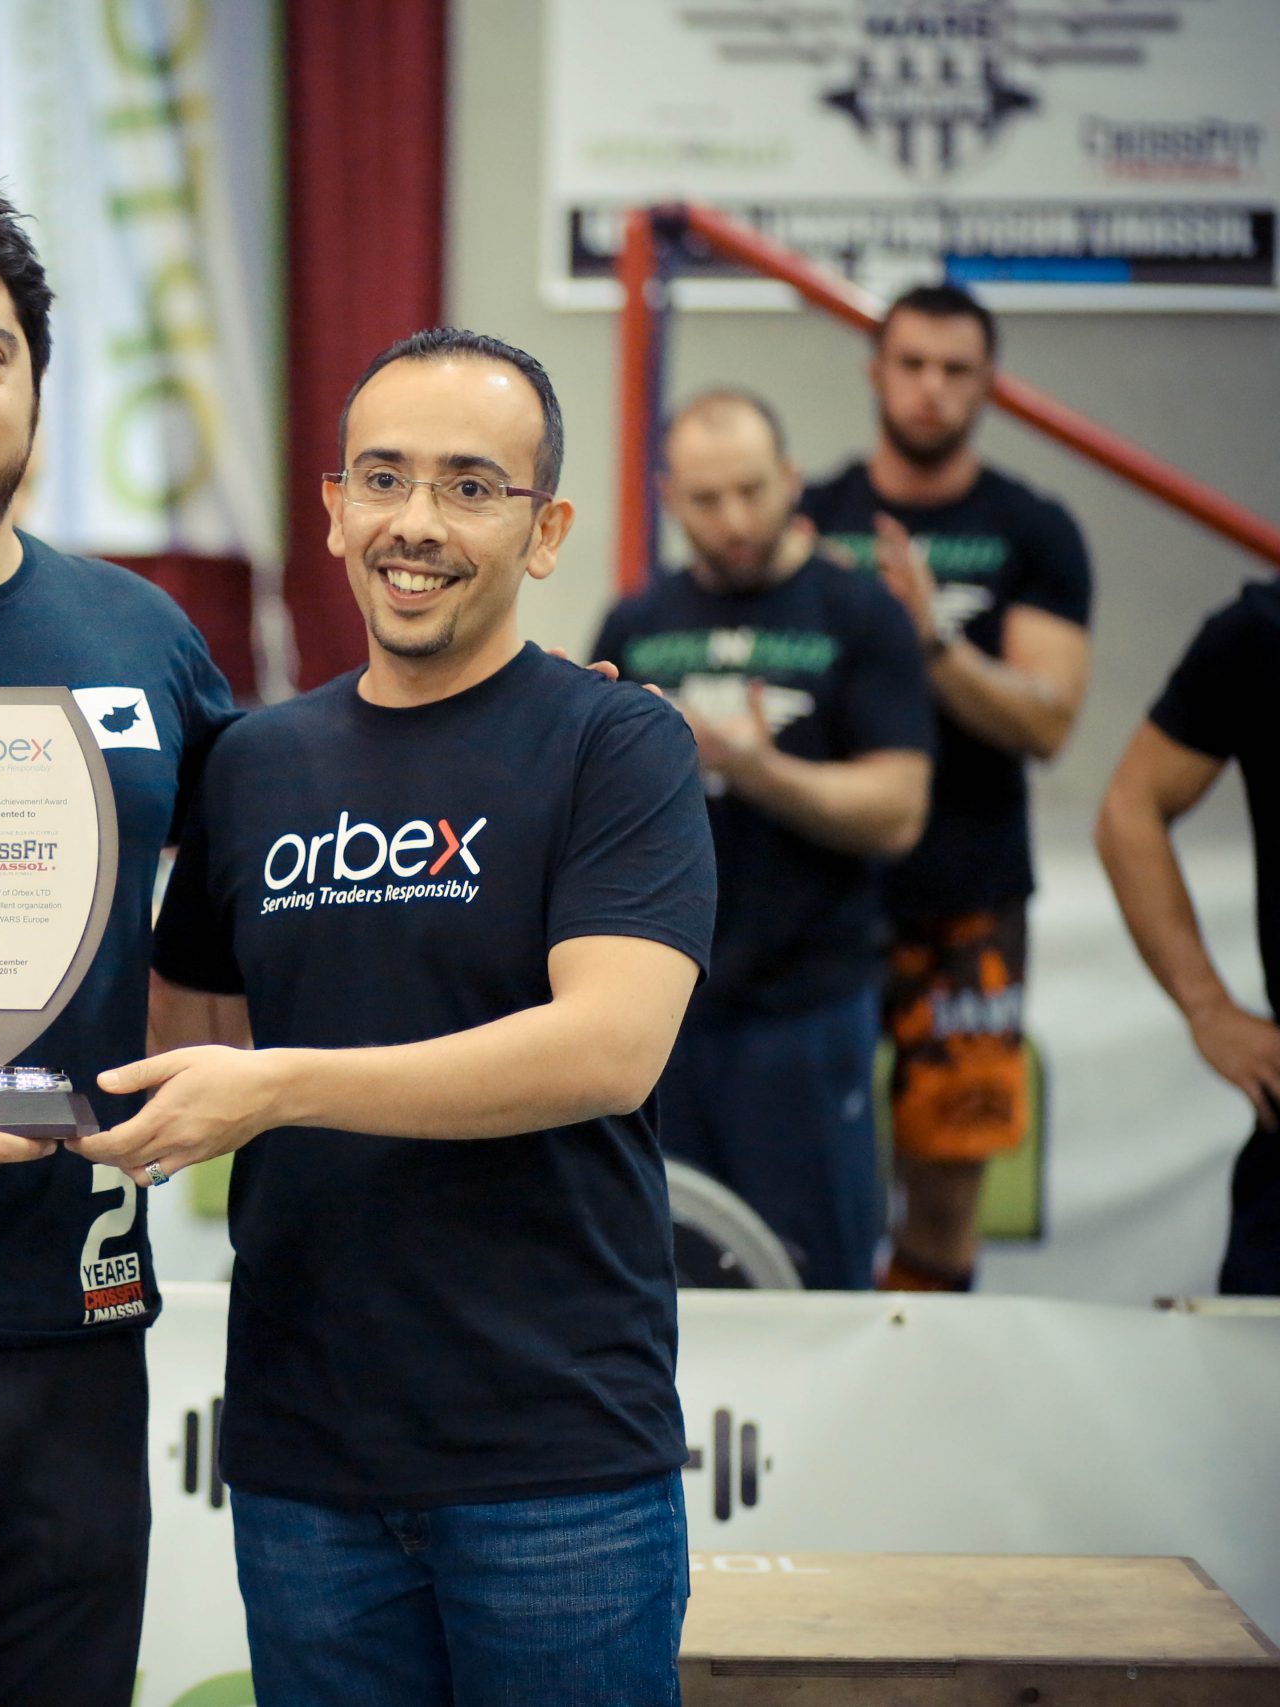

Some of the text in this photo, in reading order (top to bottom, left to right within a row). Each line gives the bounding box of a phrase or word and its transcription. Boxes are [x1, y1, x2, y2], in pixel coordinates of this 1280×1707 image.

[44, 798, 68, 806] Award
[27, 810, 36, 818] to
[264, 810, 487, 890] orbex
[2, 889, 10, 897] of
[11, 889, 34, 897] Orbex
[36, 889, 51, 897] LTD
[261, 880, 480, 915] Serving Traders Responsibly
[17, 902, 62, 911] organization
[23, 916, 50, 925] Europe
[0, 967, 18, 975] 2015
[80, 1163, 137, 1272] 2
[83, 1256, 138, 1288] YEARS
[84, 1281, 144, 1311] CROSSFIT
